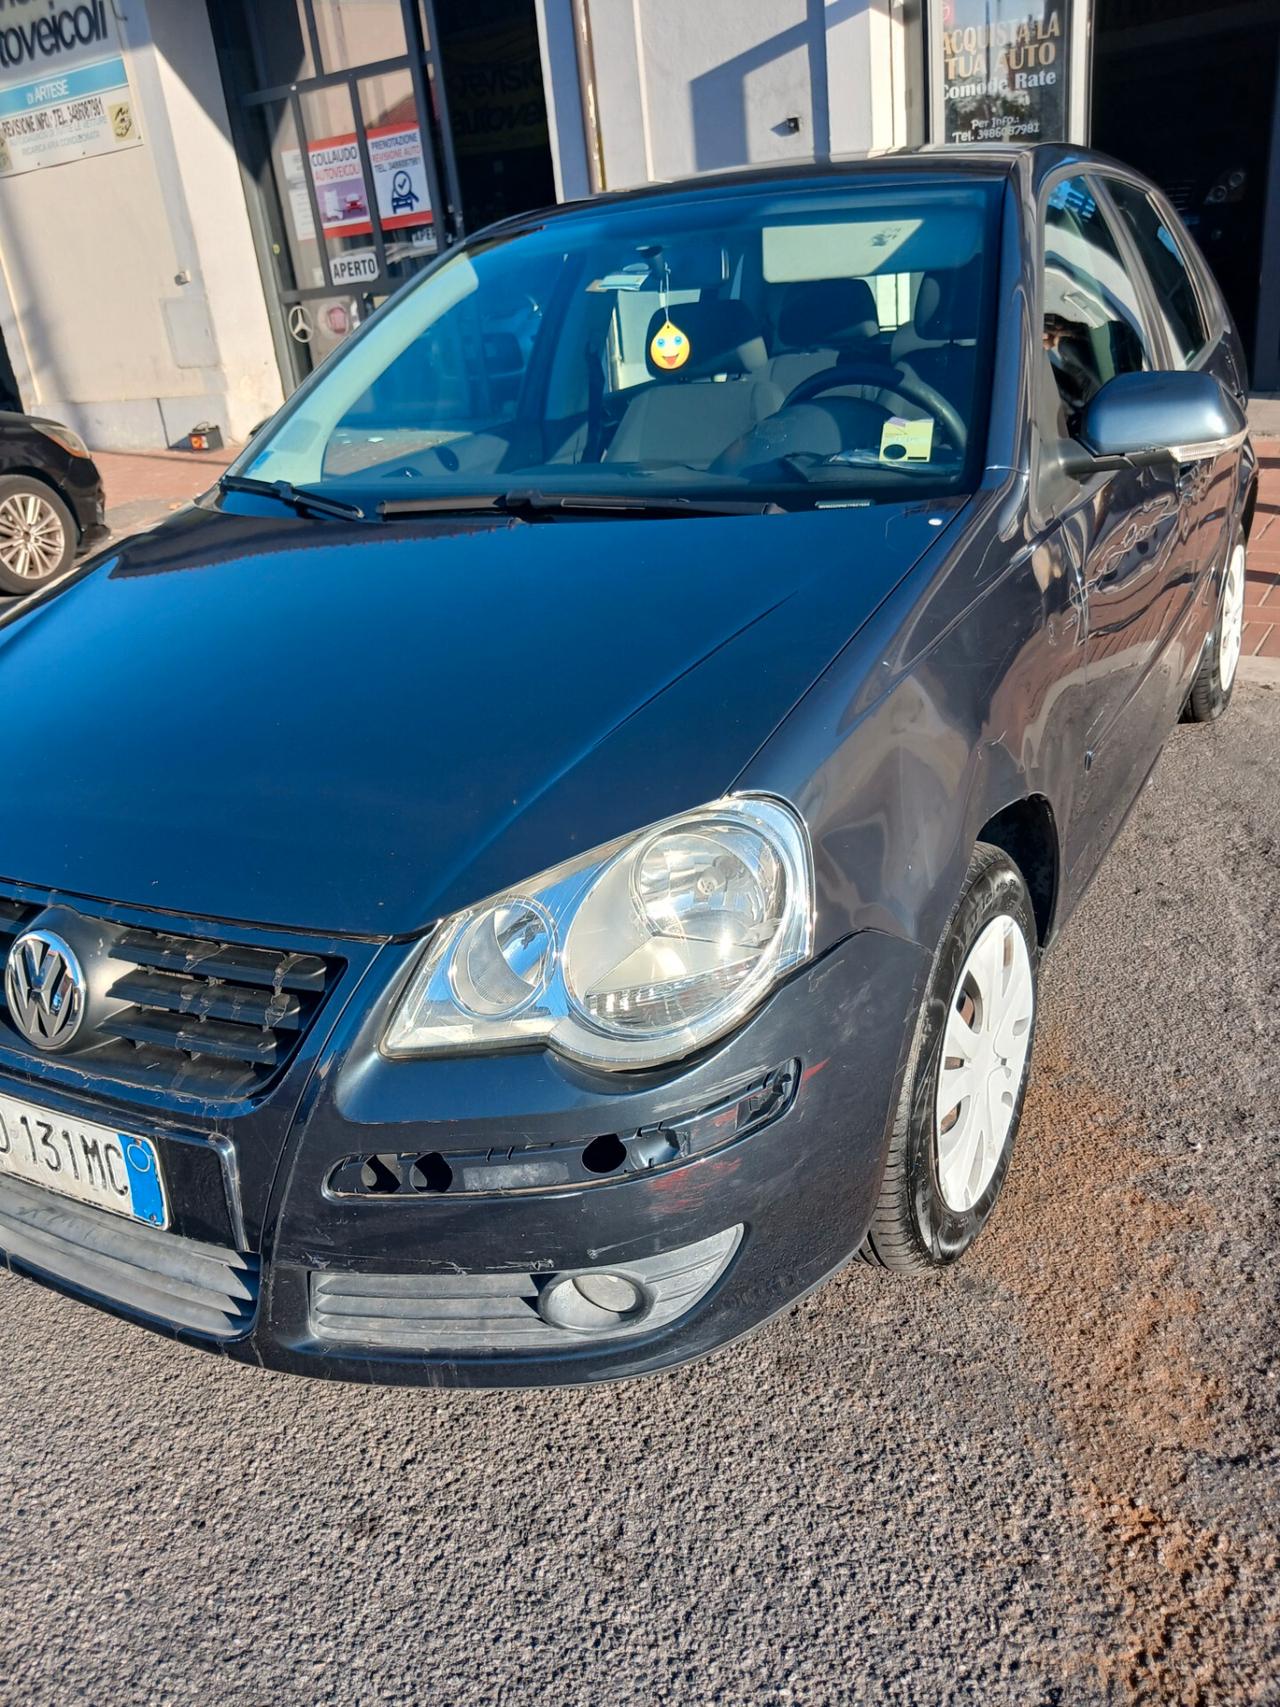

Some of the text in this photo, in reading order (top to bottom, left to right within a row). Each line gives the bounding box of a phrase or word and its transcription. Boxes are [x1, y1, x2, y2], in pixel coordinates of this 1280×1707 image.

[942, 10, 1060, 55] ACQUISTA LA
[944, 41, 1056, 80] TUA AUTO
[1015, 70, 1057, 89] Rate
[971, 118, 989, 129] Per
[371, 132, 418, 149] PRENOTAZIONE
[952, 130, 975, 143] Tel.
[311, 146, 358, 167] COLLAUDO
[333, 258, 376, 279] APERTO
